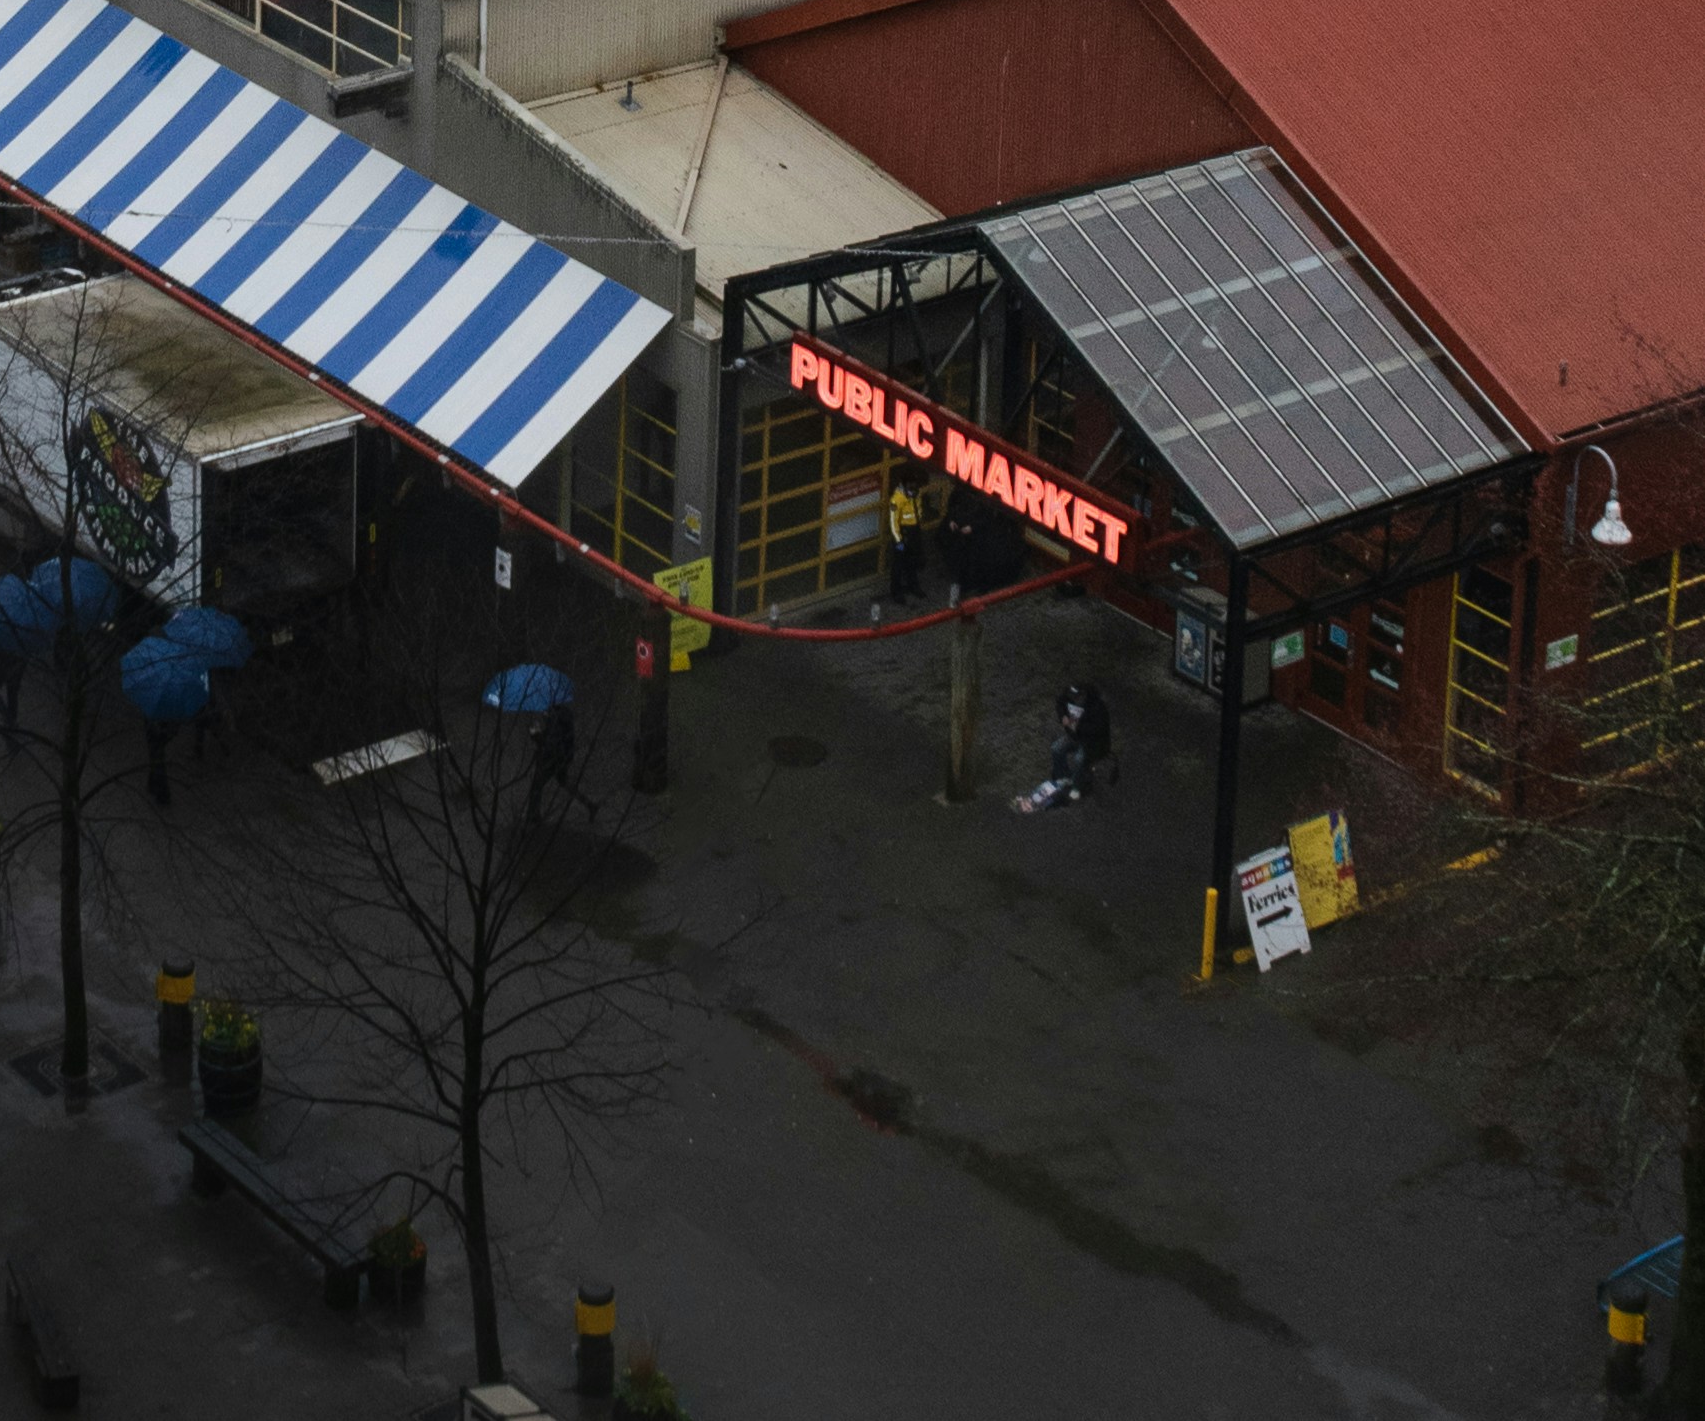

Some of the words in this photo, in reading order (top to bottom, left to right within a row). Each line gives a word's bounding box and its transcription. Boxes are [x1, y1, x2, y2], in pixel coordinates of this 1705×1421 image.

[790, 341, 934, 460] PUBLIC
[945, 426, 1127, 566] MARKET
[1248, 882, 1297, 914] Ferries
